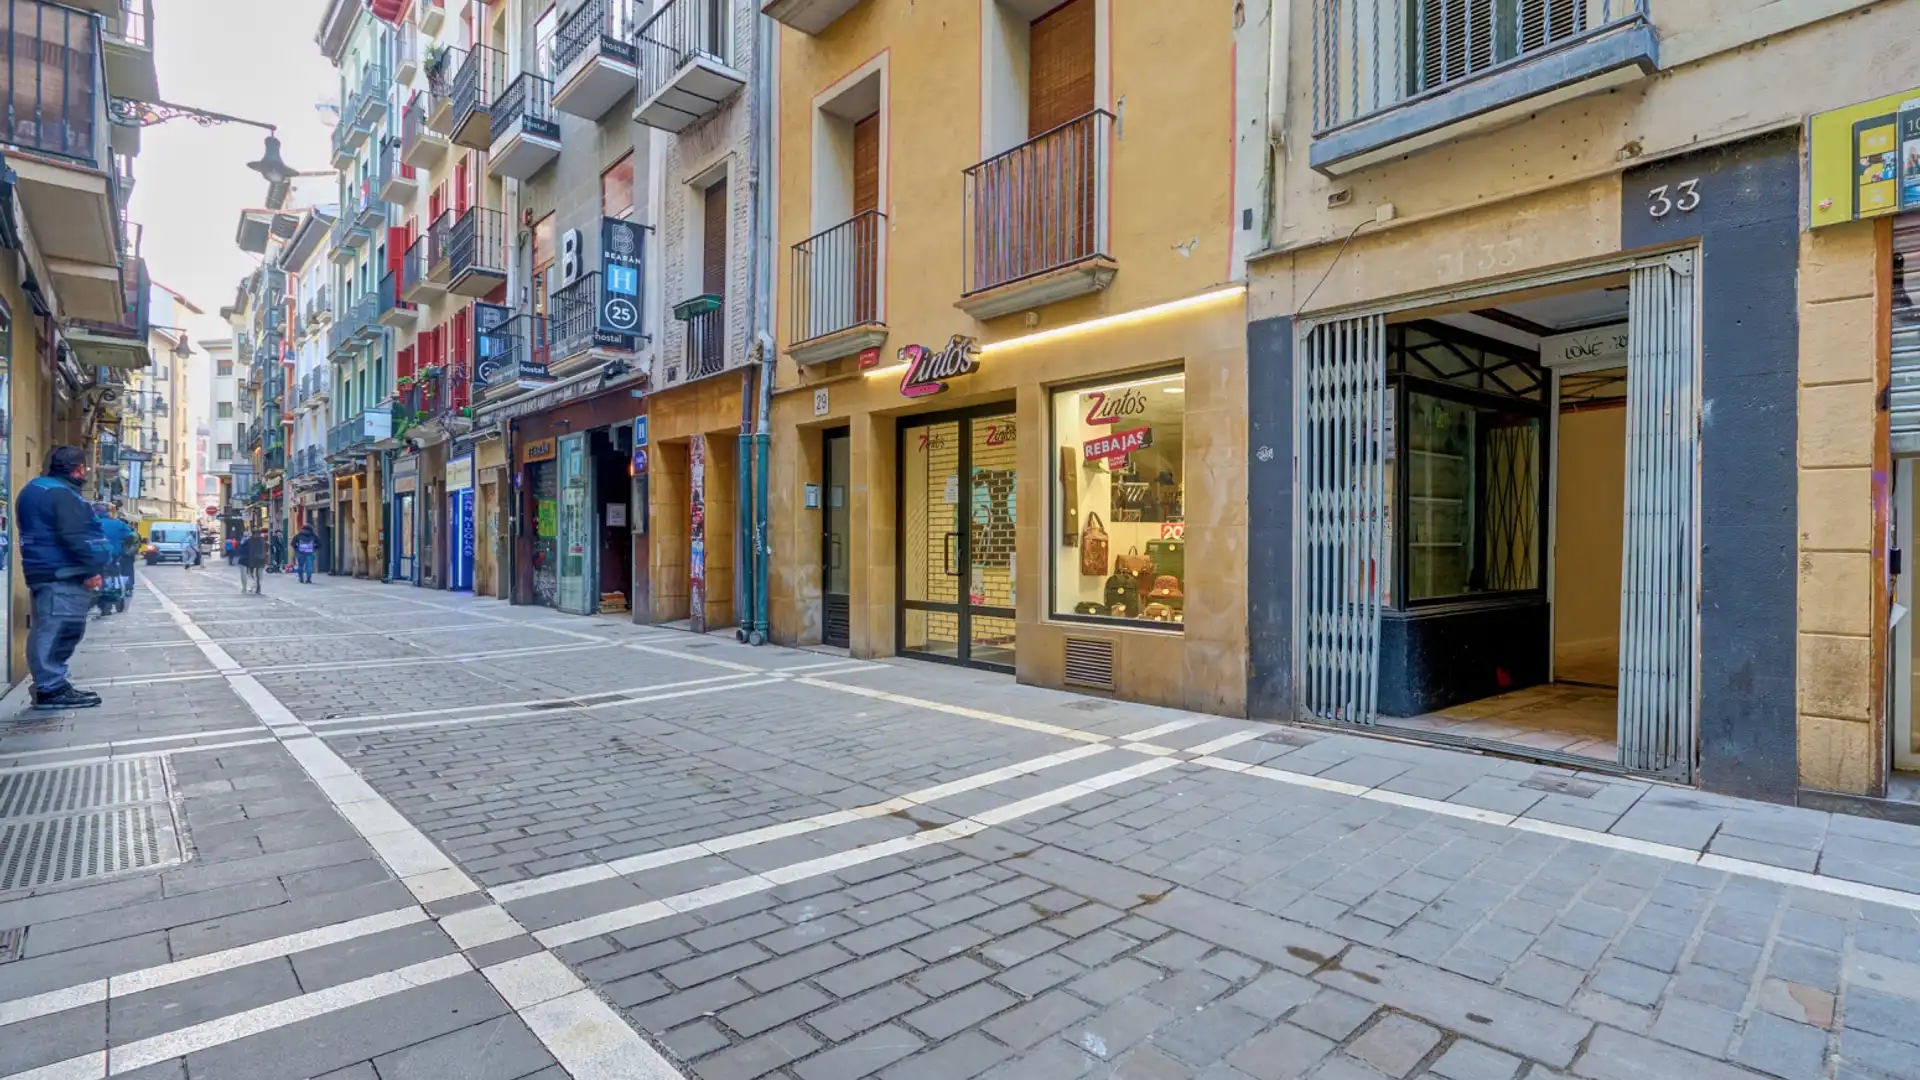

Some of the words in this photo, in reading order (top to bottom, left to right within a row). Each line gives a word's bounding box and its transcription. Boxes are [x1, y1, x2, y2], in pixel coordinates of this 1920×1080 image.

[603, 40, 629, 54] hostal
[1648, 178, 1700, 217] 33
[562, 228, 583, 288] B
[613, 268, 632, 292] H
[612, 306, 631, 321] 25
[595, 331, 622, 344] hostal
[520, 364, 545, 375] hostal
[900, 338, 974, 398] Zinto's
[816, 393, 828, 411] 29
[1086, 388, 1147, 426] Zinto's
[1085, 431, 1145, 457] REBAJAS
